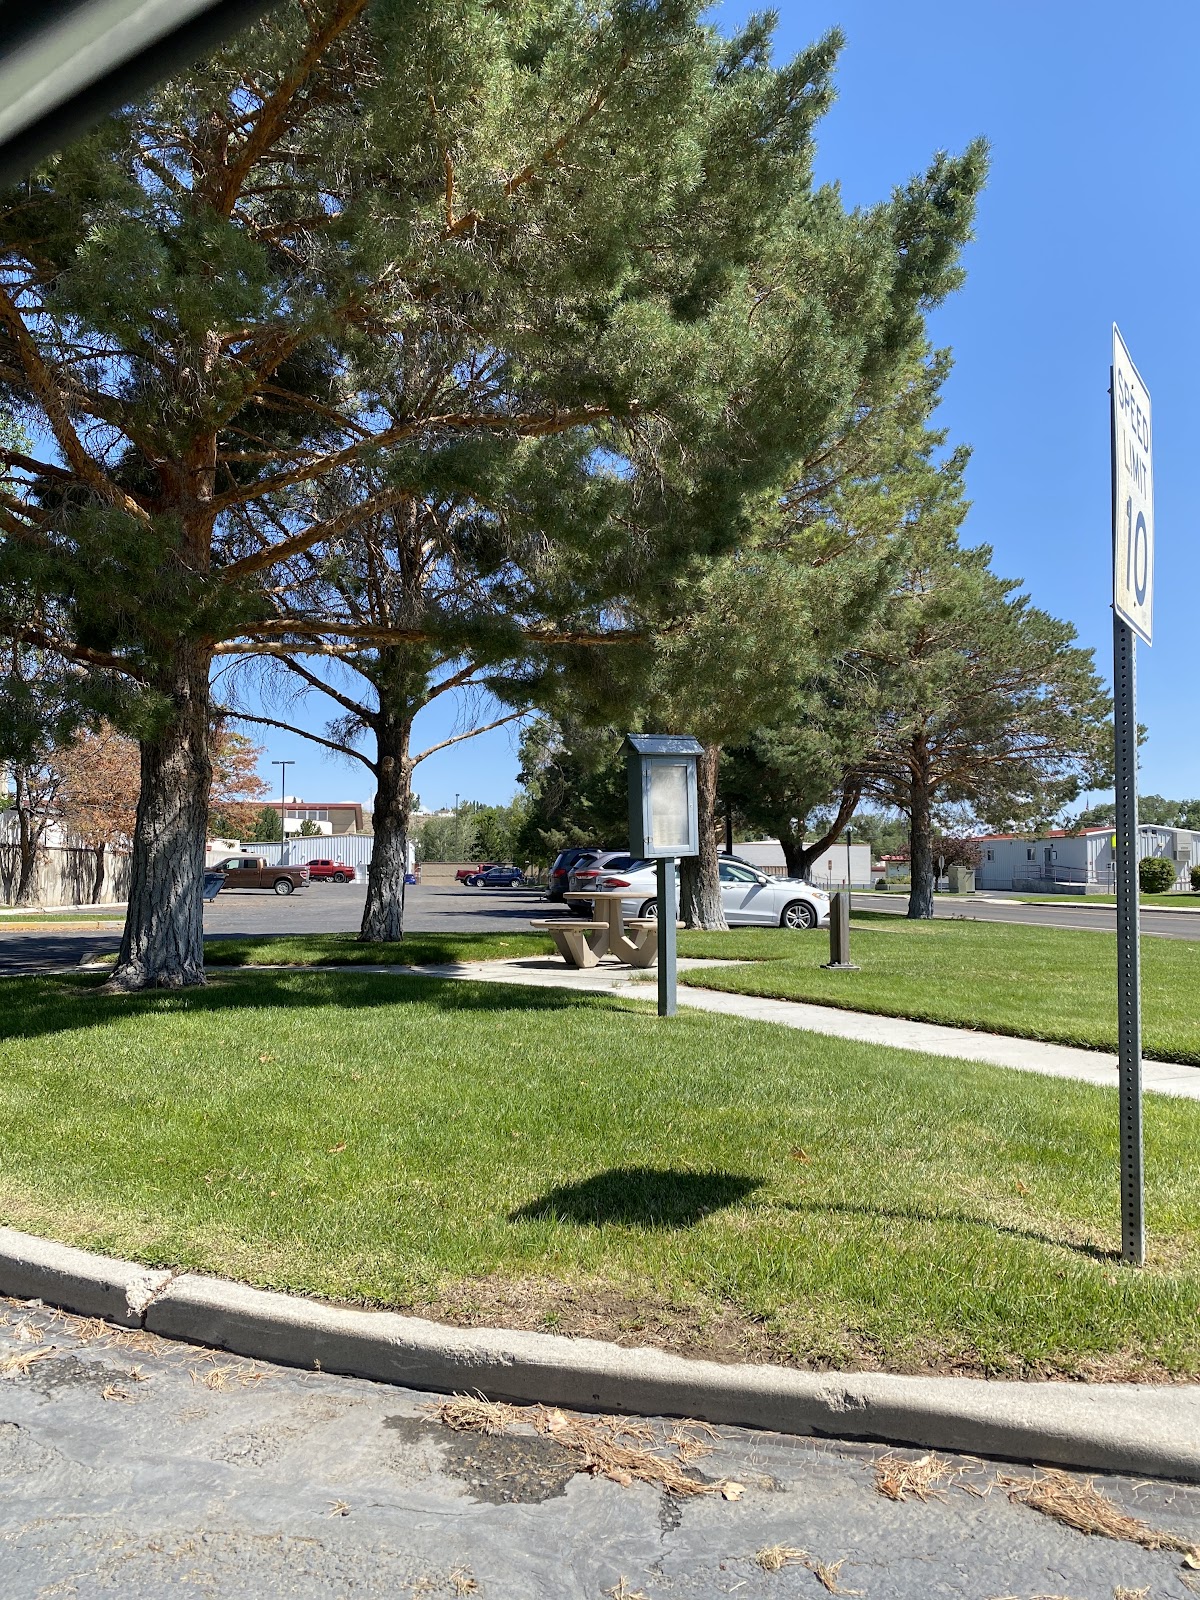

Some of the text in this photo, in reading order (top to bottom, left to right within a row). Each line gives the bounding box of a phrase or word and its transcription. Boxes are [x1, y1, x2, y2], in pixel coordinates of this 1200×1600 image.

[1118, 367, 1148, 453] SPEED
[1123, 429, 1147, 499] LIMIT
[1127, 495, 1147, 606] 10
